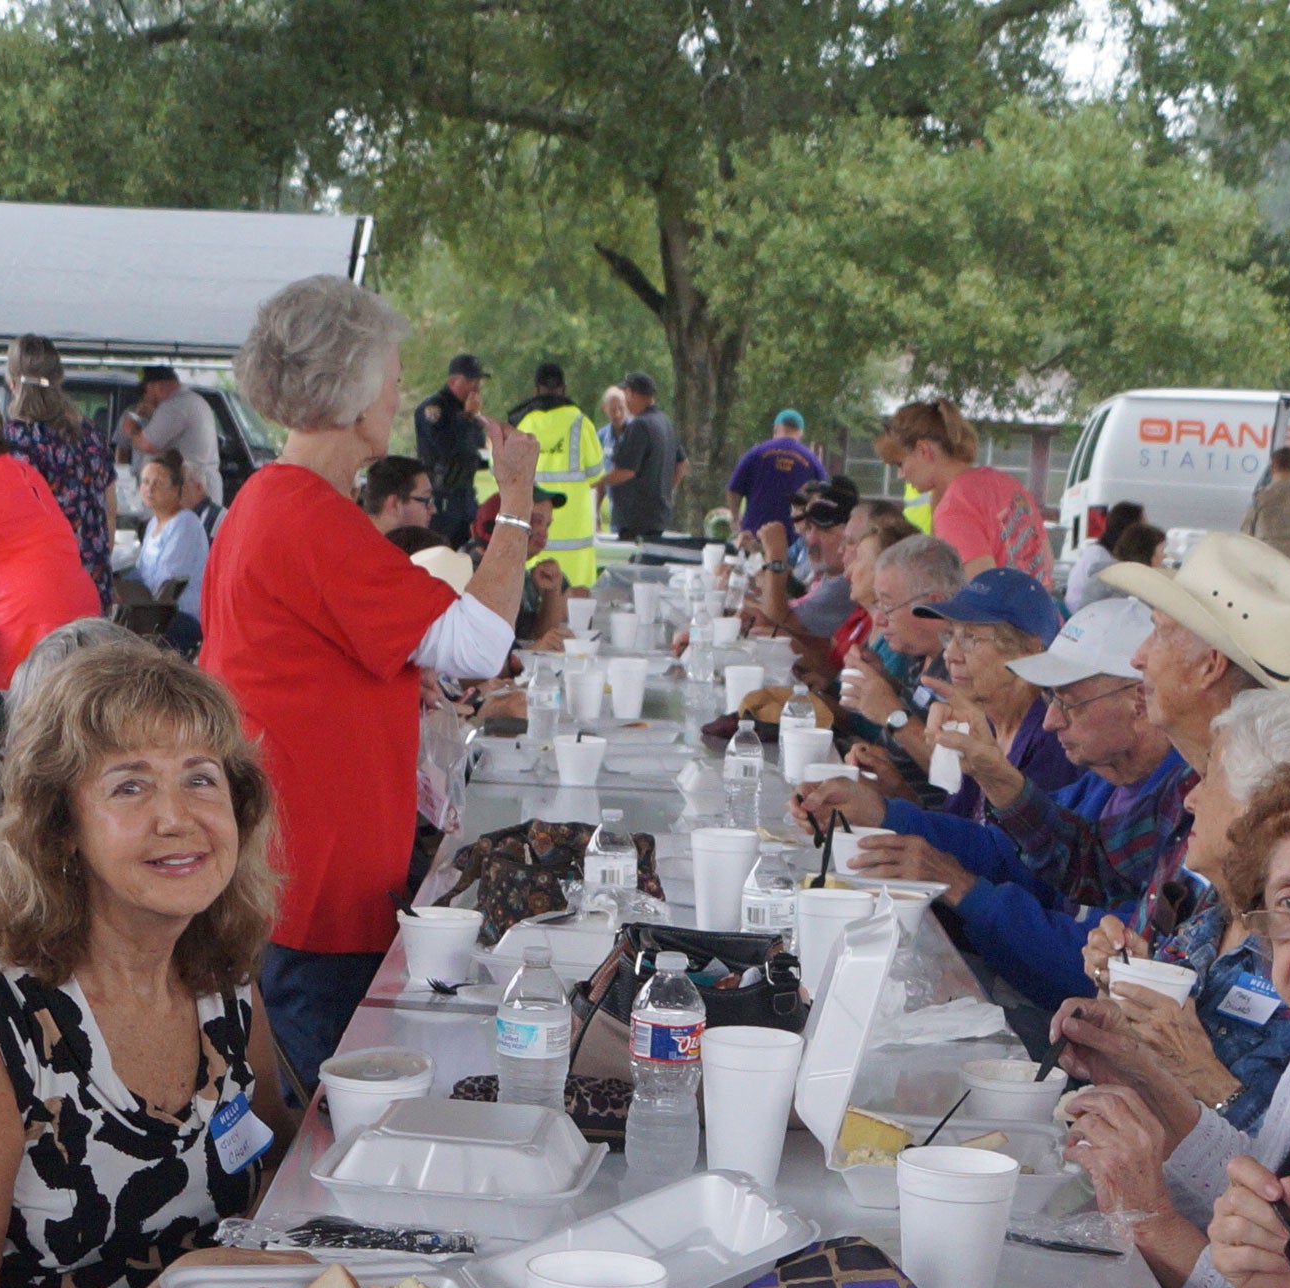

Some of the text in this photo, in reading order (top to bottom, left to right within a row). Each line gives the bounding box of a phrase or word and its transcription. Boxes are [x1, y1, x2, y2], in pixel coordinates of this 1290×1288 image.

[1139, 449, 1260, 474] STATIO
[1250, 977, 1277, 993] HELLO
[220, 1102, 240, 1125] HELLO
